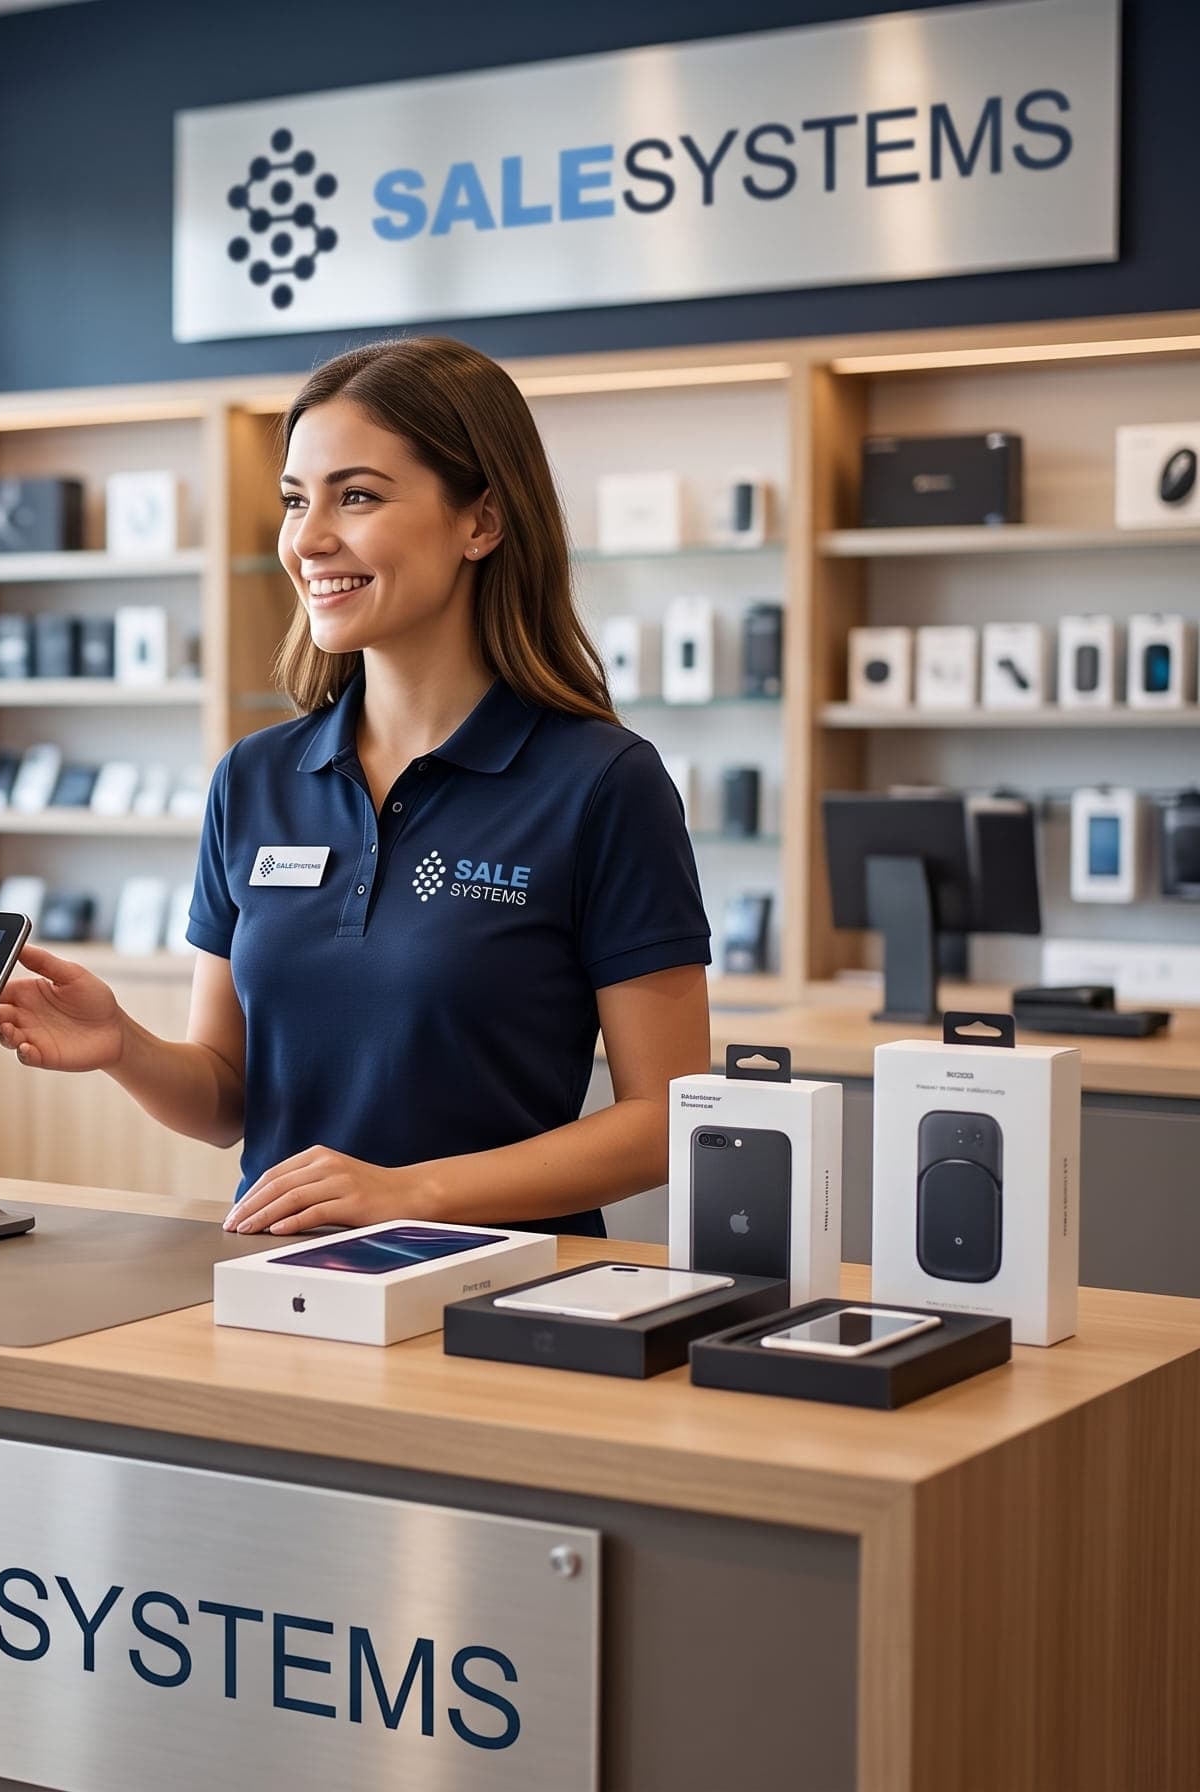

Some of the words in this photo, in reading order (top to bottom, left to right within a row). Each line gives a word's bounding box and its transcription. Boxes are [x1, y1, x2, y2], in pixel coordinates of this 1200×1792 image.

[373, 89, 1073, 241] SALESYSTEMS
[455, 859, 531, 889] SALE
[449, 882, 528, 906] SYSTEMS
